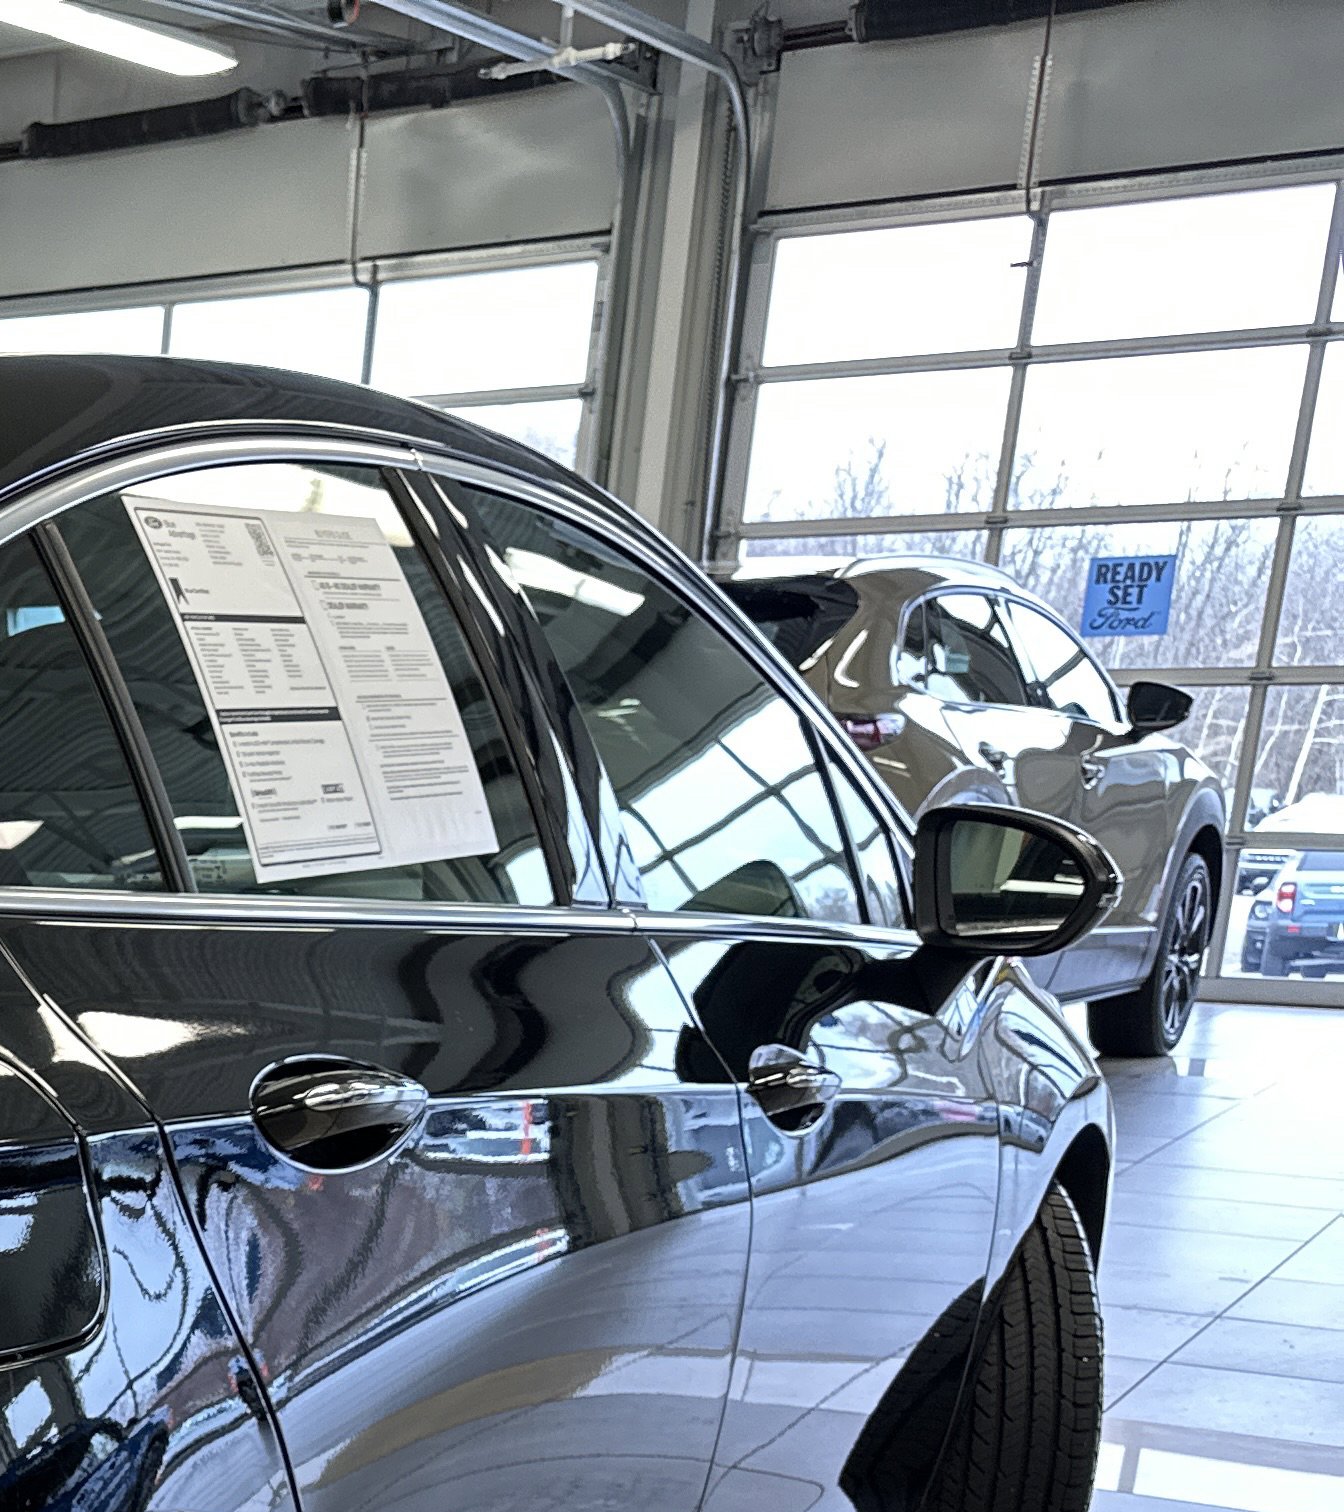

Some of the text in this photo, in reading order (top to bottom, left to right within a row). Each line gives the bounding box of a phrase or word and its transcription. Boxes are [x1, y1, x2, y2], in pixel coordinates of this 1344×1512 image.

[1094, 561, 1168, 585] READY
[1106, 584, 1148, 606] SET
[1089, 606, 1156, 631] Ford
